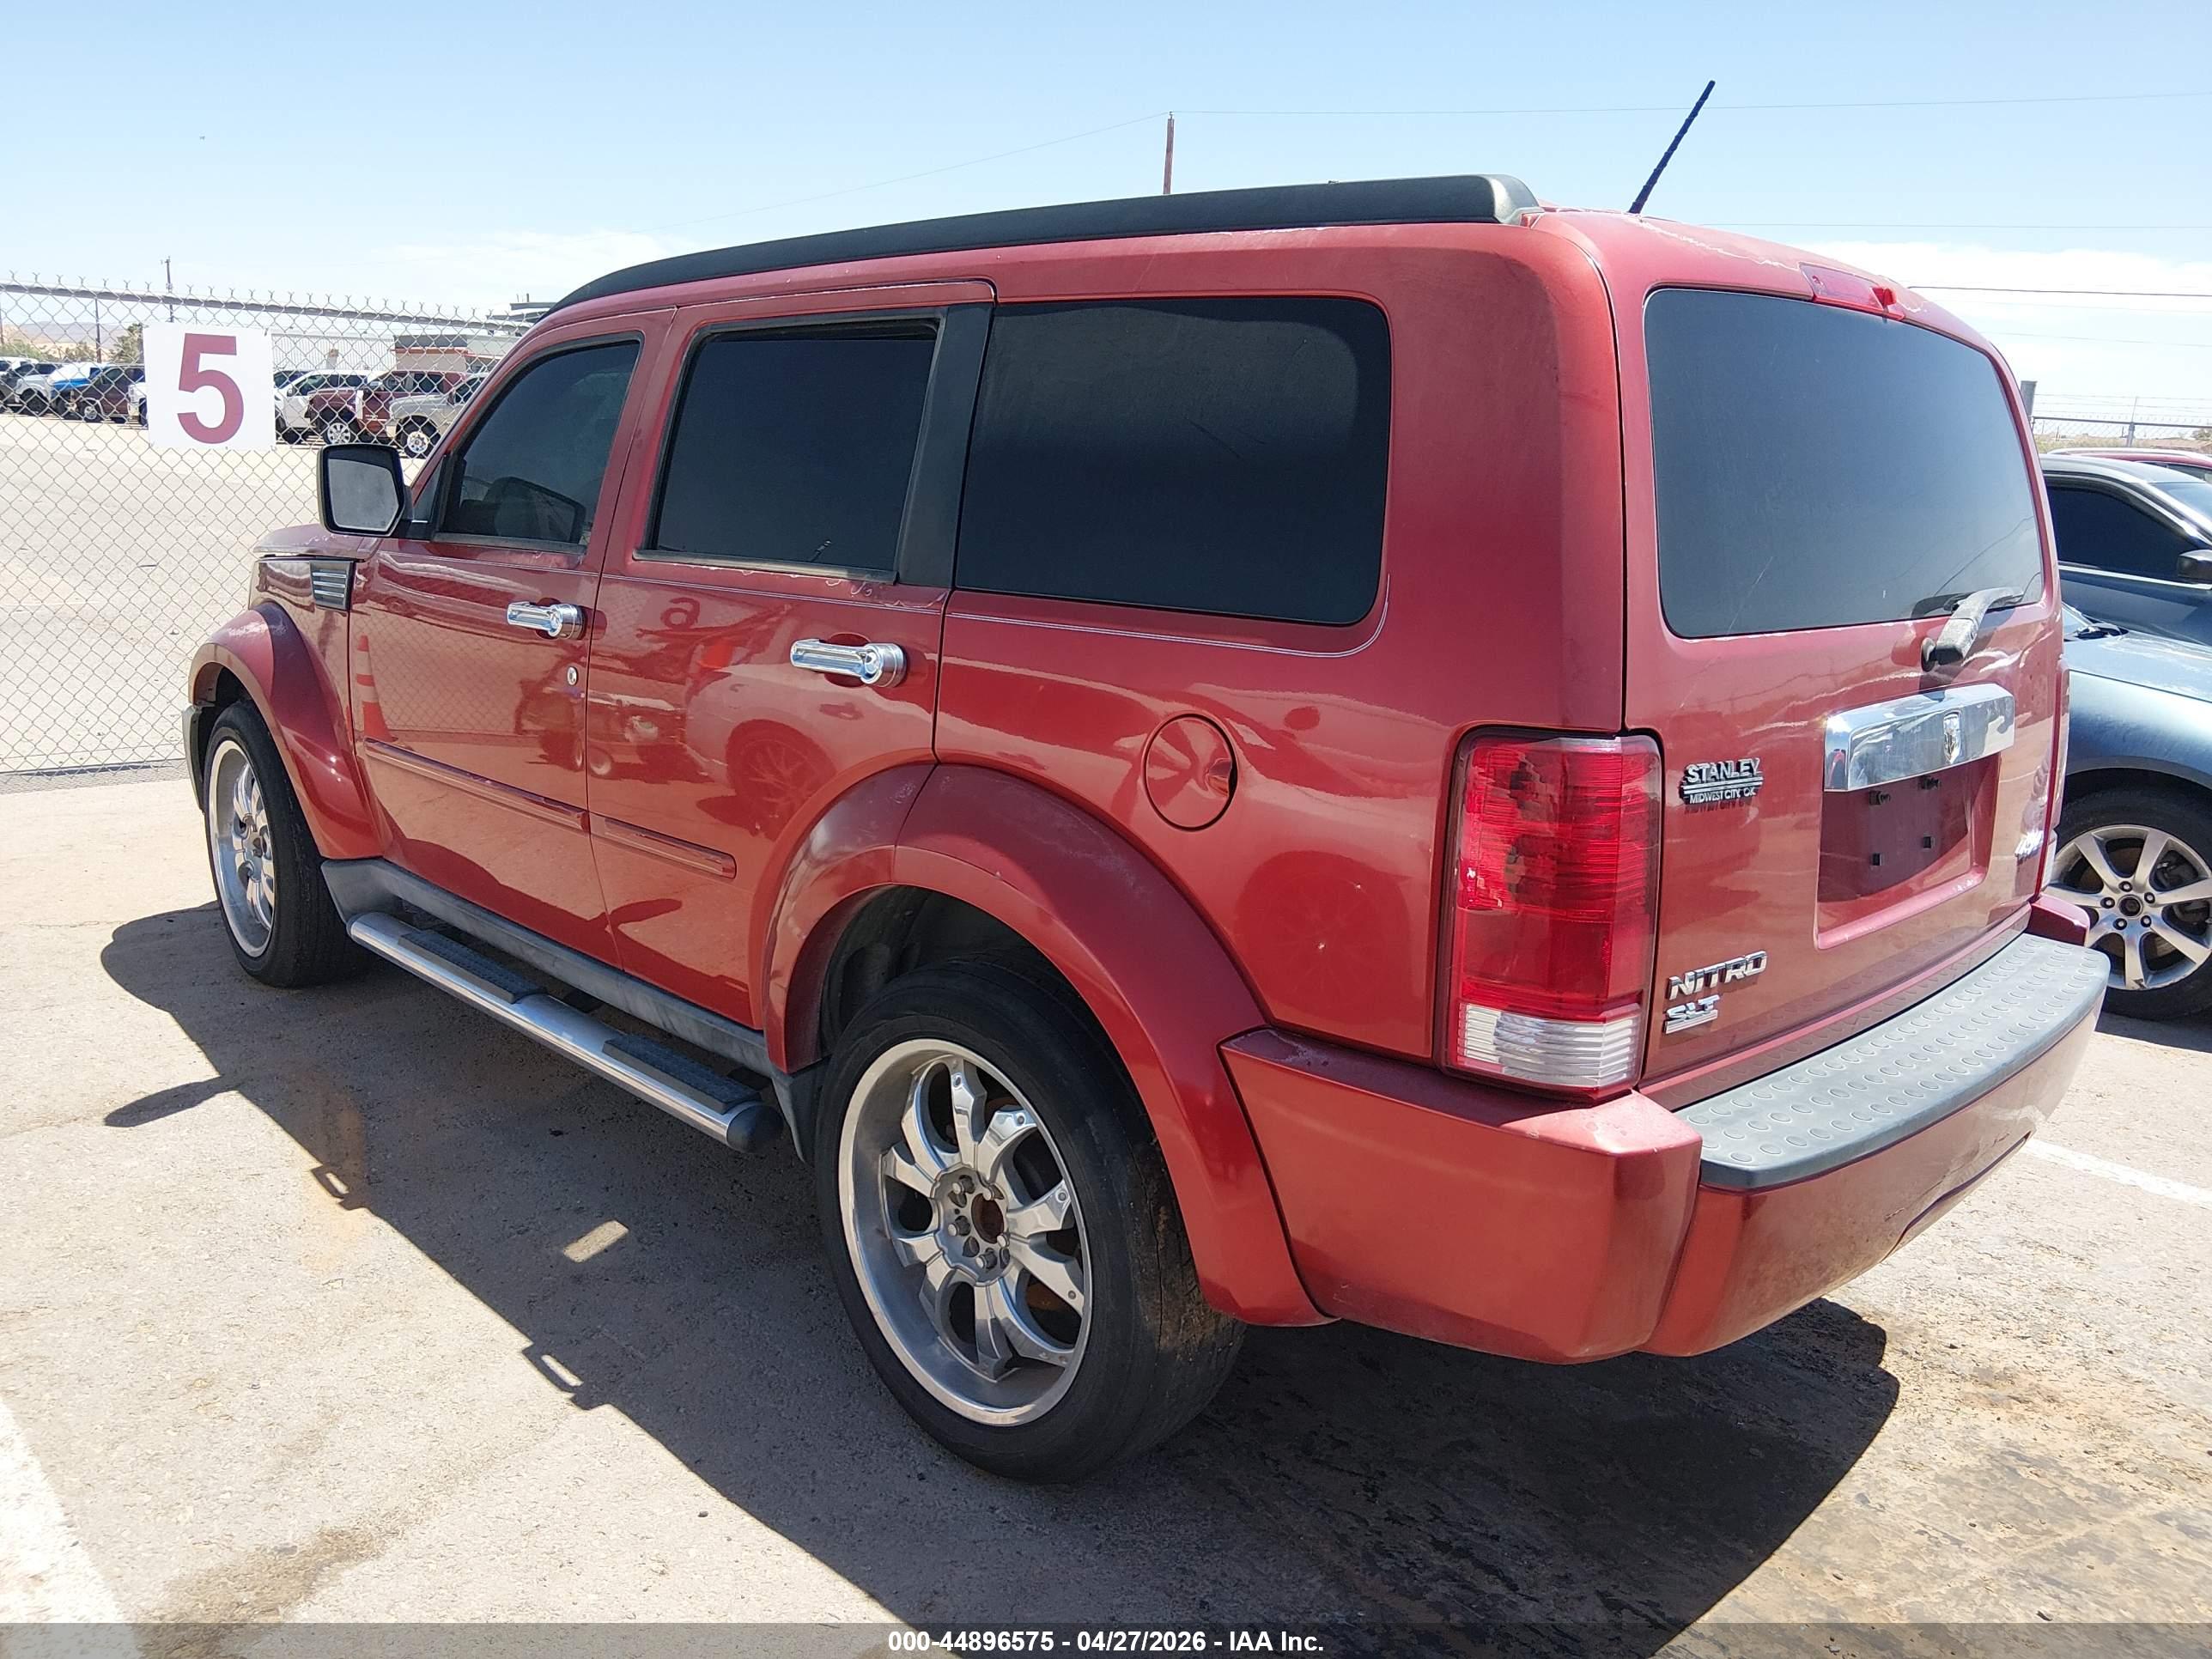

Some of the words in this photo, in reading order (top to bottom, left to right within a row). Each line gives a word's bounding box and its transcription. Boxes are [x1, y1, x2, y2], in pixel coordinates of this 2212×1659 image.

[177, 332, 245, 445] 5
[1685, 757, 1761, 783] STANLEY
[1689, 790, 1723, 804] MIDWEST
[1724, 787, 1741, 800] CITY
[1668, 950, 1768, 1001] NITRO
[1666, 994, 1721, 1022] SLT
